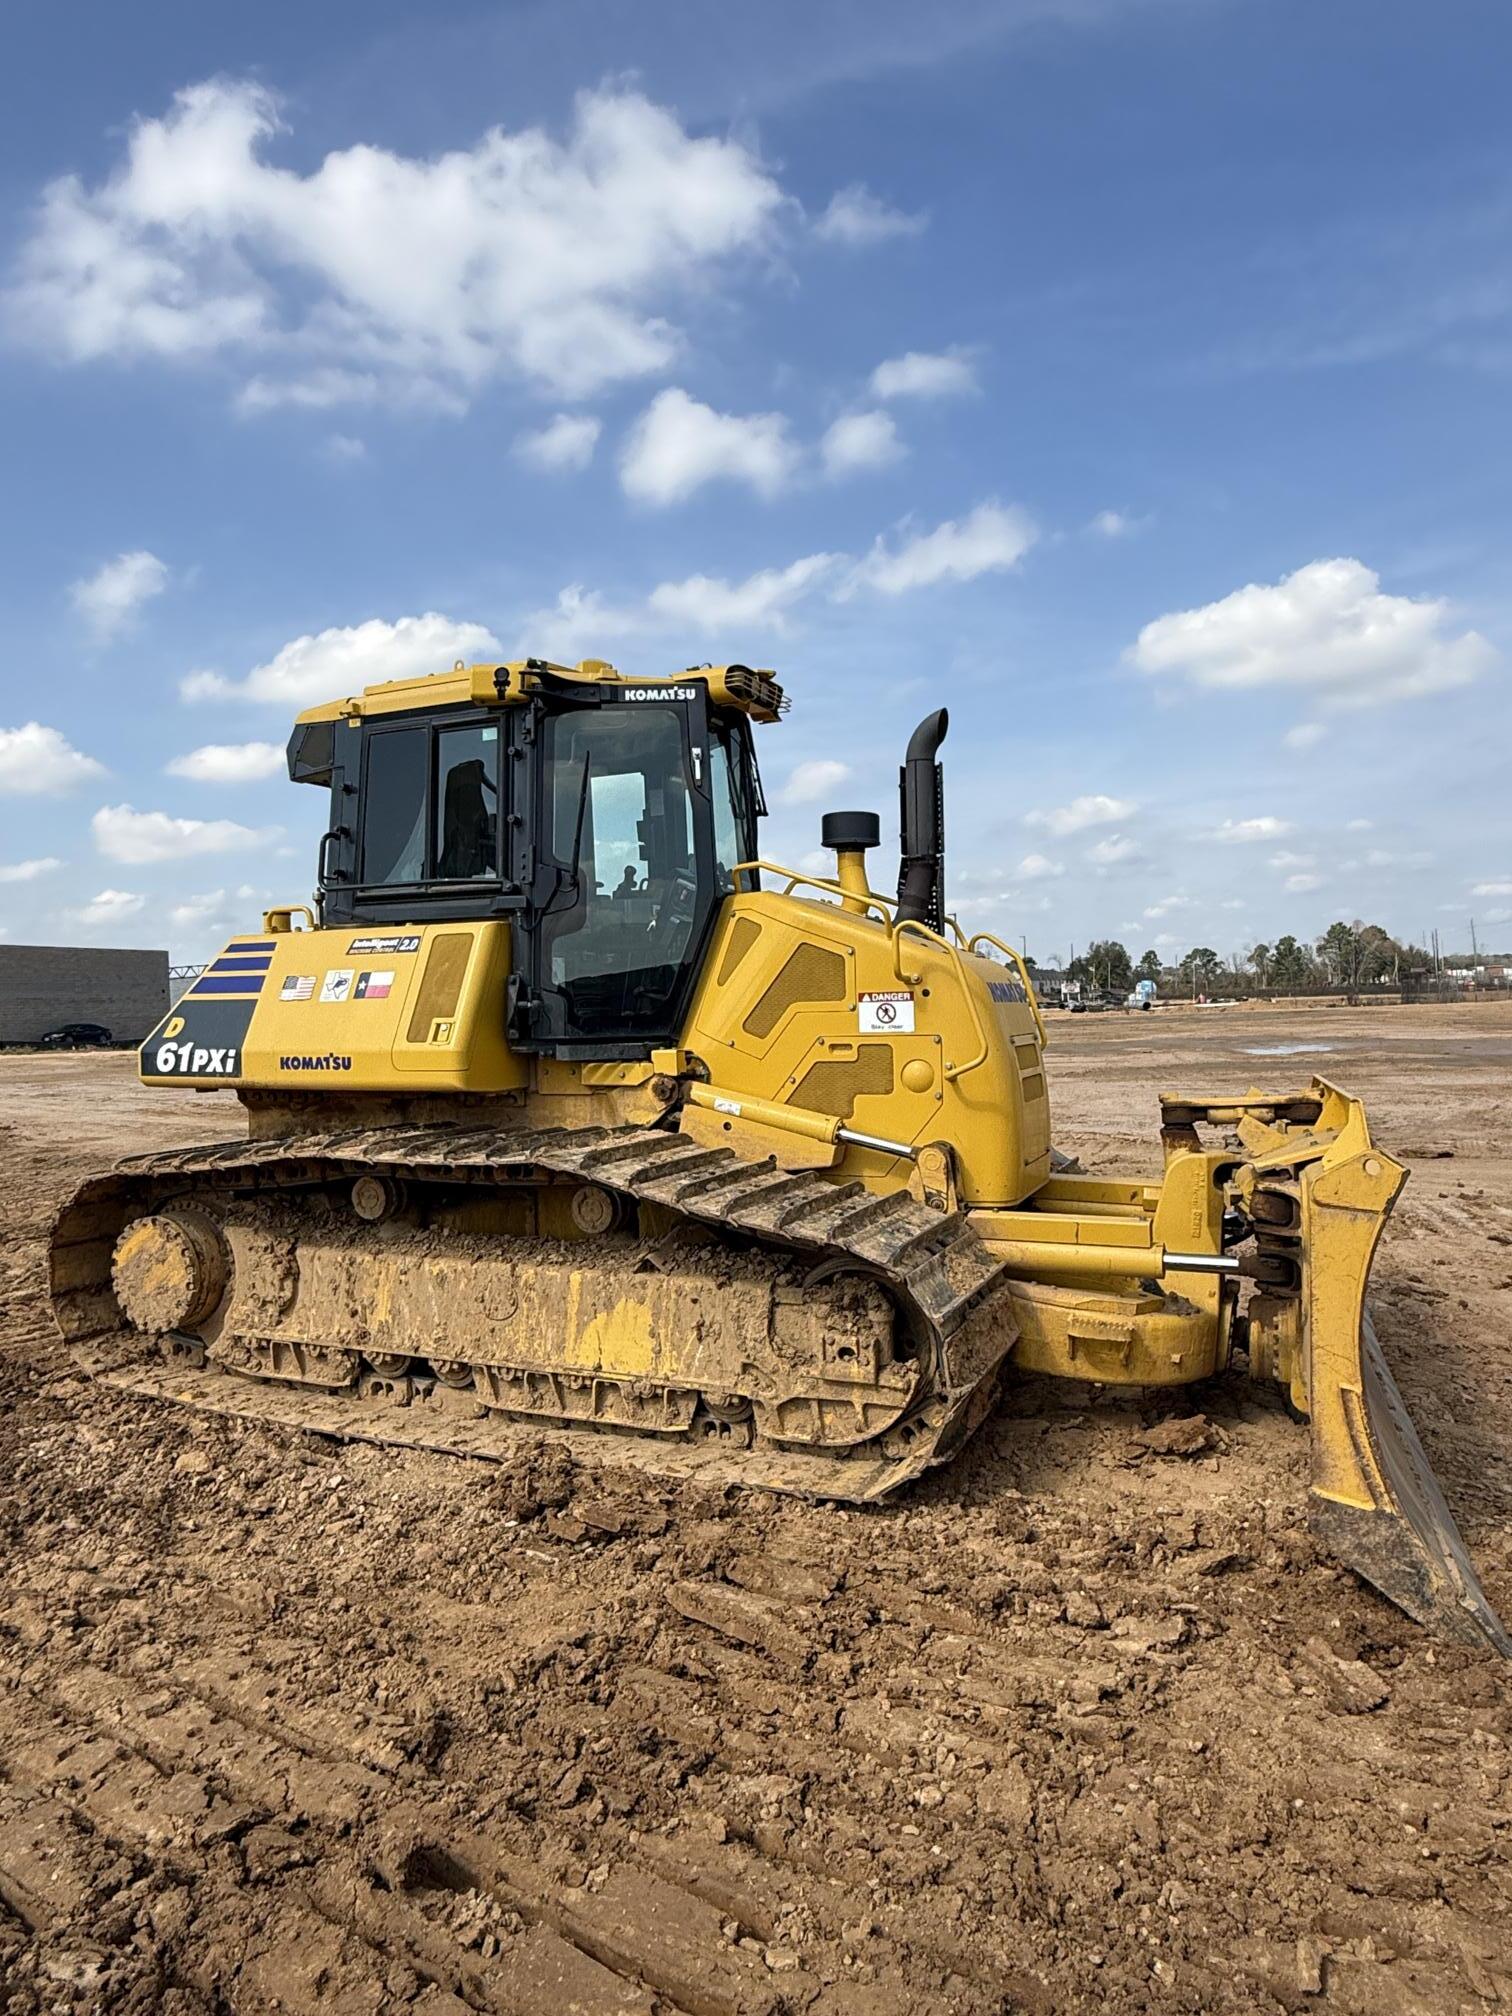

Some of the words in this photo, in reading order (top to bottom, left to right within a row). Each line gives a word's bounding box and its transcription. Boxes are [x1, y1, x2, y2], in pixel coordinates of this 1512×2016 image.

[625, 686, 696, 701] KOMATSU
[399, 938, 419, 951] 2.0
[871, 992, 911, 1001] DANGER
[162, 1017, 186, 1038] D
[156, 1041, 237, 1073] 61PXi
[280, 1052, 352, 1071] KOMATSU
